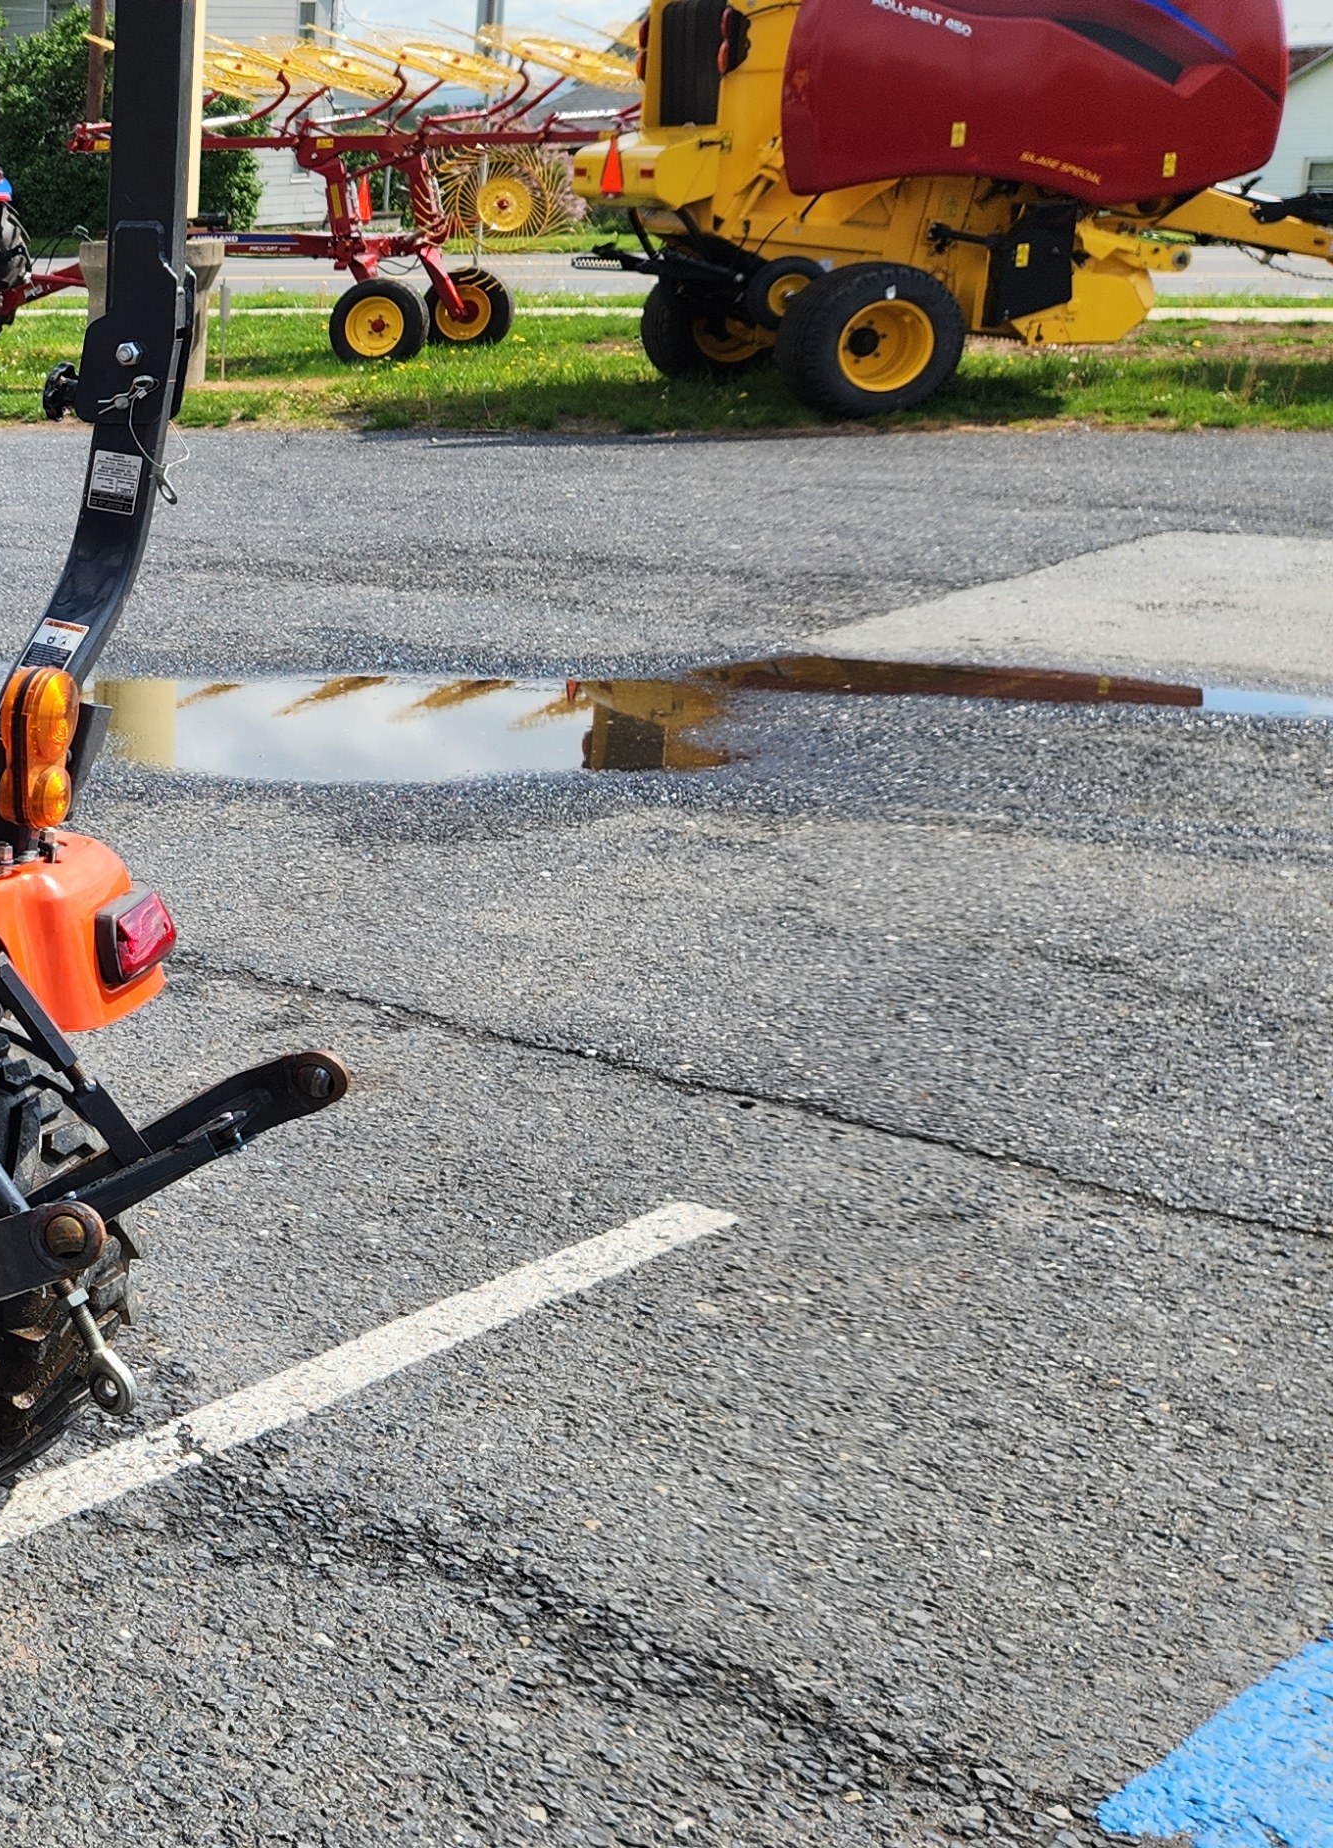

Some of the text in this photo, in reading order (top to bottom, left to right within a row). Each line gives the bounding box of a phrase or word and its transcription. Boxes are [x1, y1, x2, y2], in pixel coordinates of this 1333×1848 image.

[945, 18, 973, 38] 450
[1019, 151, 1102, 186] SILAGE SPECIAL
